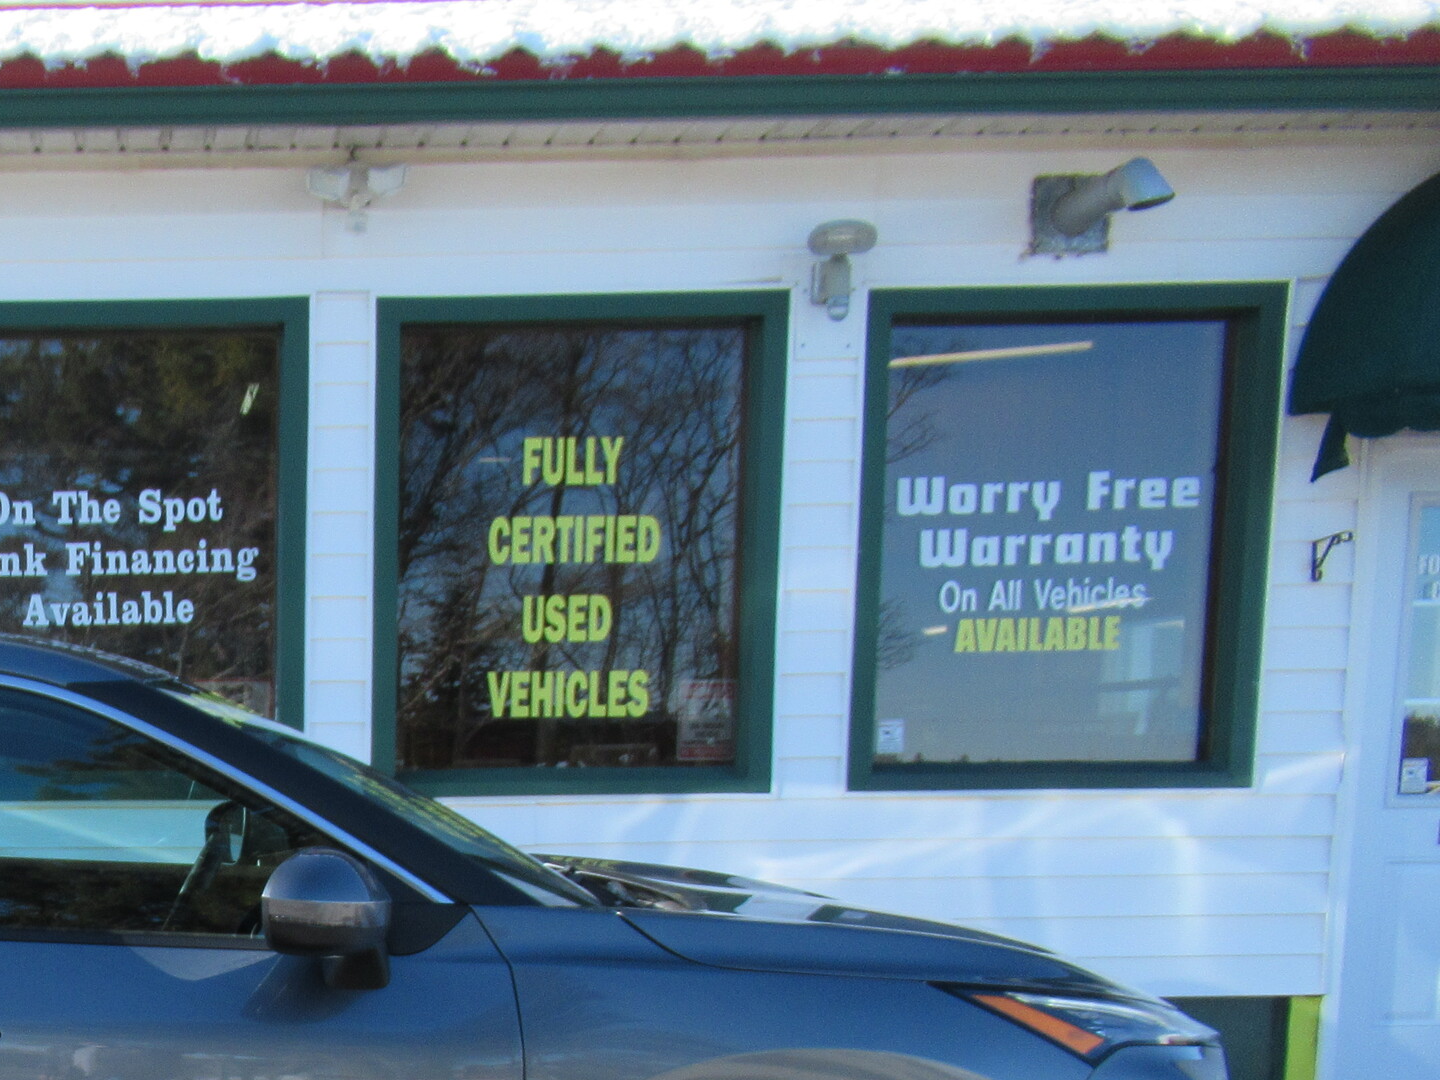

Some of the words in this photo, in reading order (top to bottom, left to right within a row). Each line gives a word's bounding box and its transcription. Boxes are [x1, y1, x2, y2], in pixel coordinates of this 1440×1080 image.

[522, 436, 624, 486] FULLY
[52, 490, 122, 525] The
[137, 488, 224, 532] Spot
[897, 475, 1060, 521] Worry
[1087, 470, 1201, 510] Free
[65, 539, 259, 582] Financing
[488, 515, 662, 565] CERTIFIED
[919, 525, 1173, 571] Warranty
[23, 590, 196, 627] Available
[939, 579, 978, 614] On
[988, 579, 1023, 611] All
[1033, 576, 1148, 612] Vehicles
[522, 594, 612, 643] USED
[955, 616, 1122, 653] AVAILABLE
[487, 669, 650, 719] VEHICLES
